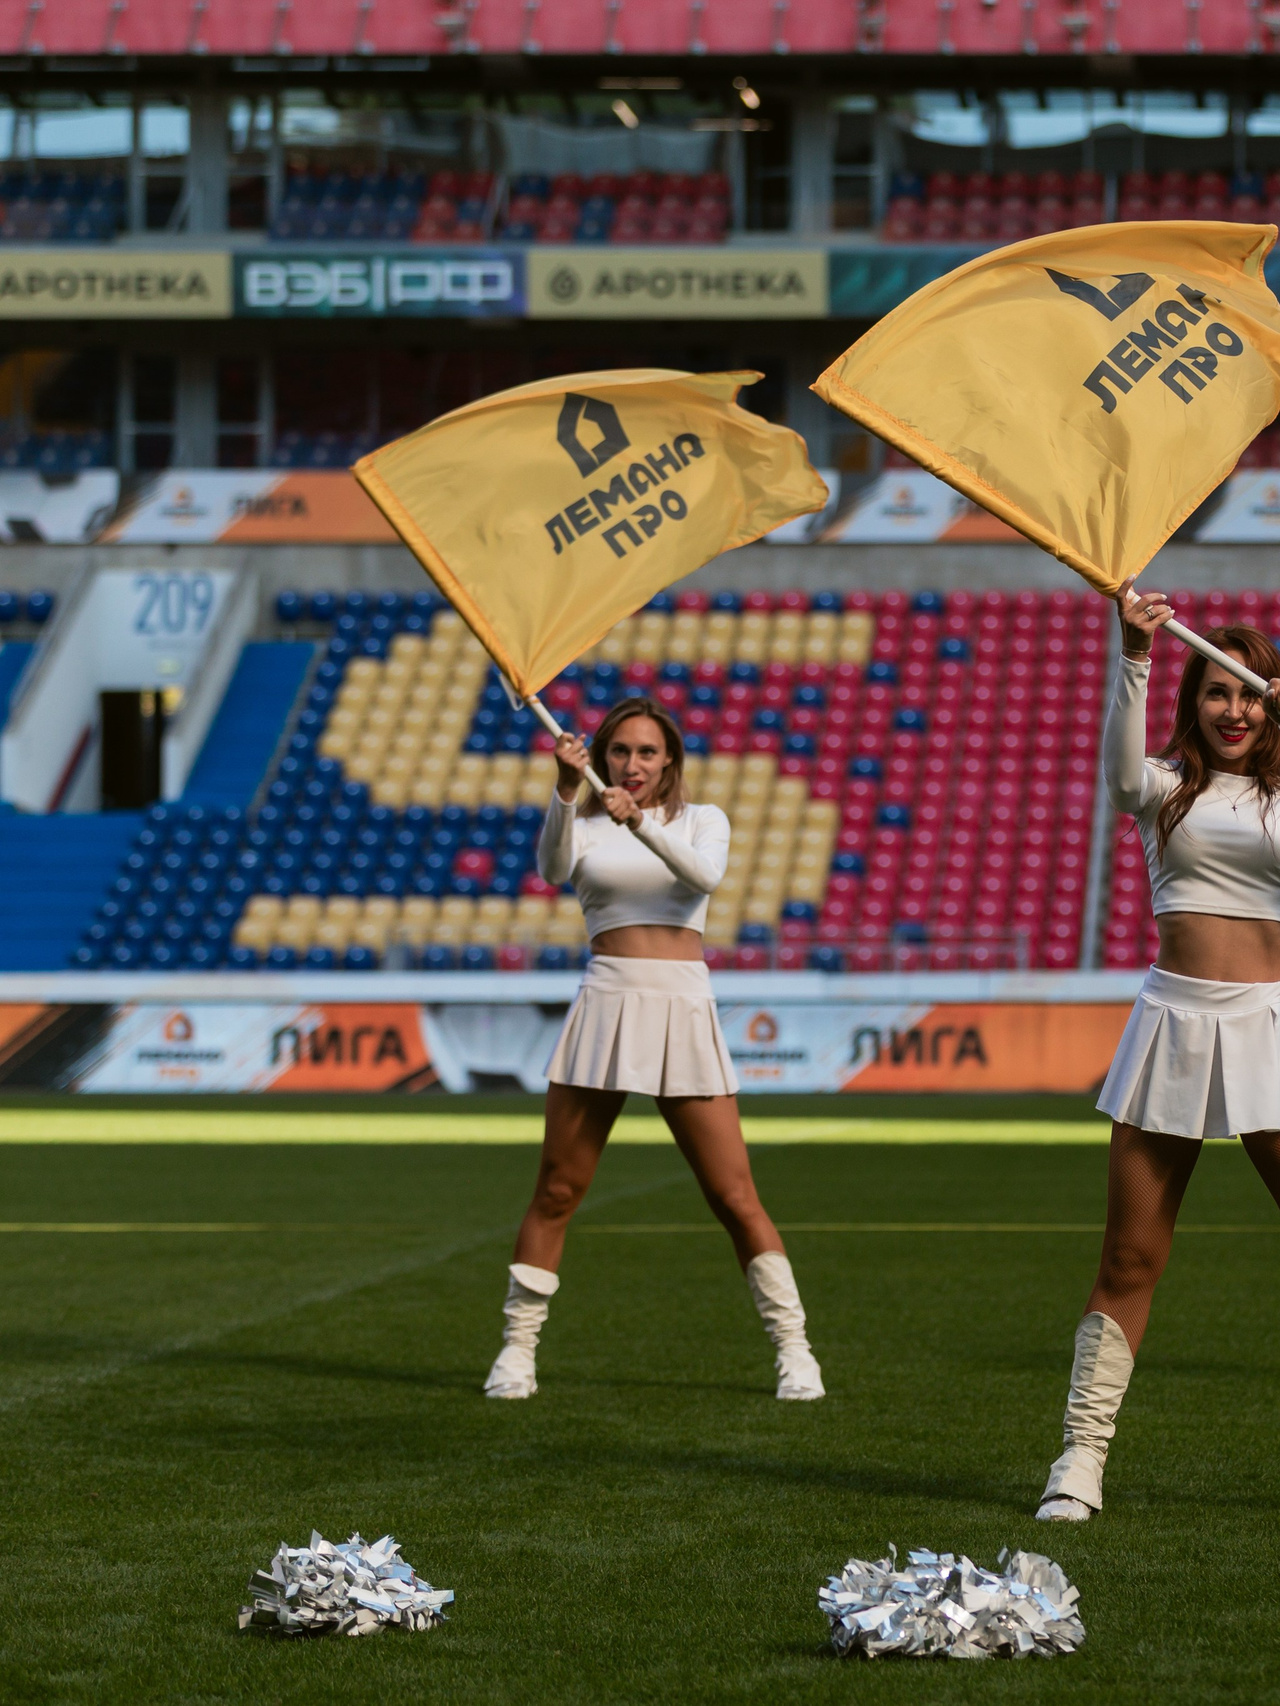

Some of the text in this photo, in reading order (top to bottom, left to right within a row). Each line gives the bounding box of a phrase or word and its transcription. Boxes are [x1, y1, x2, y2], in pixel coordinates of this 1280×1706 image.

[0, 267, 210, 299] APOTHEKA
[594, 267, 806, 300] APOTHEKA
[1082, 282, 1221, 414] ЛЕМАН
[1158, 322, 1244, 405] ПРО
[544, 433, 705, 556] ЛЕМАНА
[601, 489, 688, 559] ПРО
[132, 571, 214, 634] 209
[269, 1023, 408, 1065] ЛИГА
[849, 1024, 987, 1066] ЛИГА
